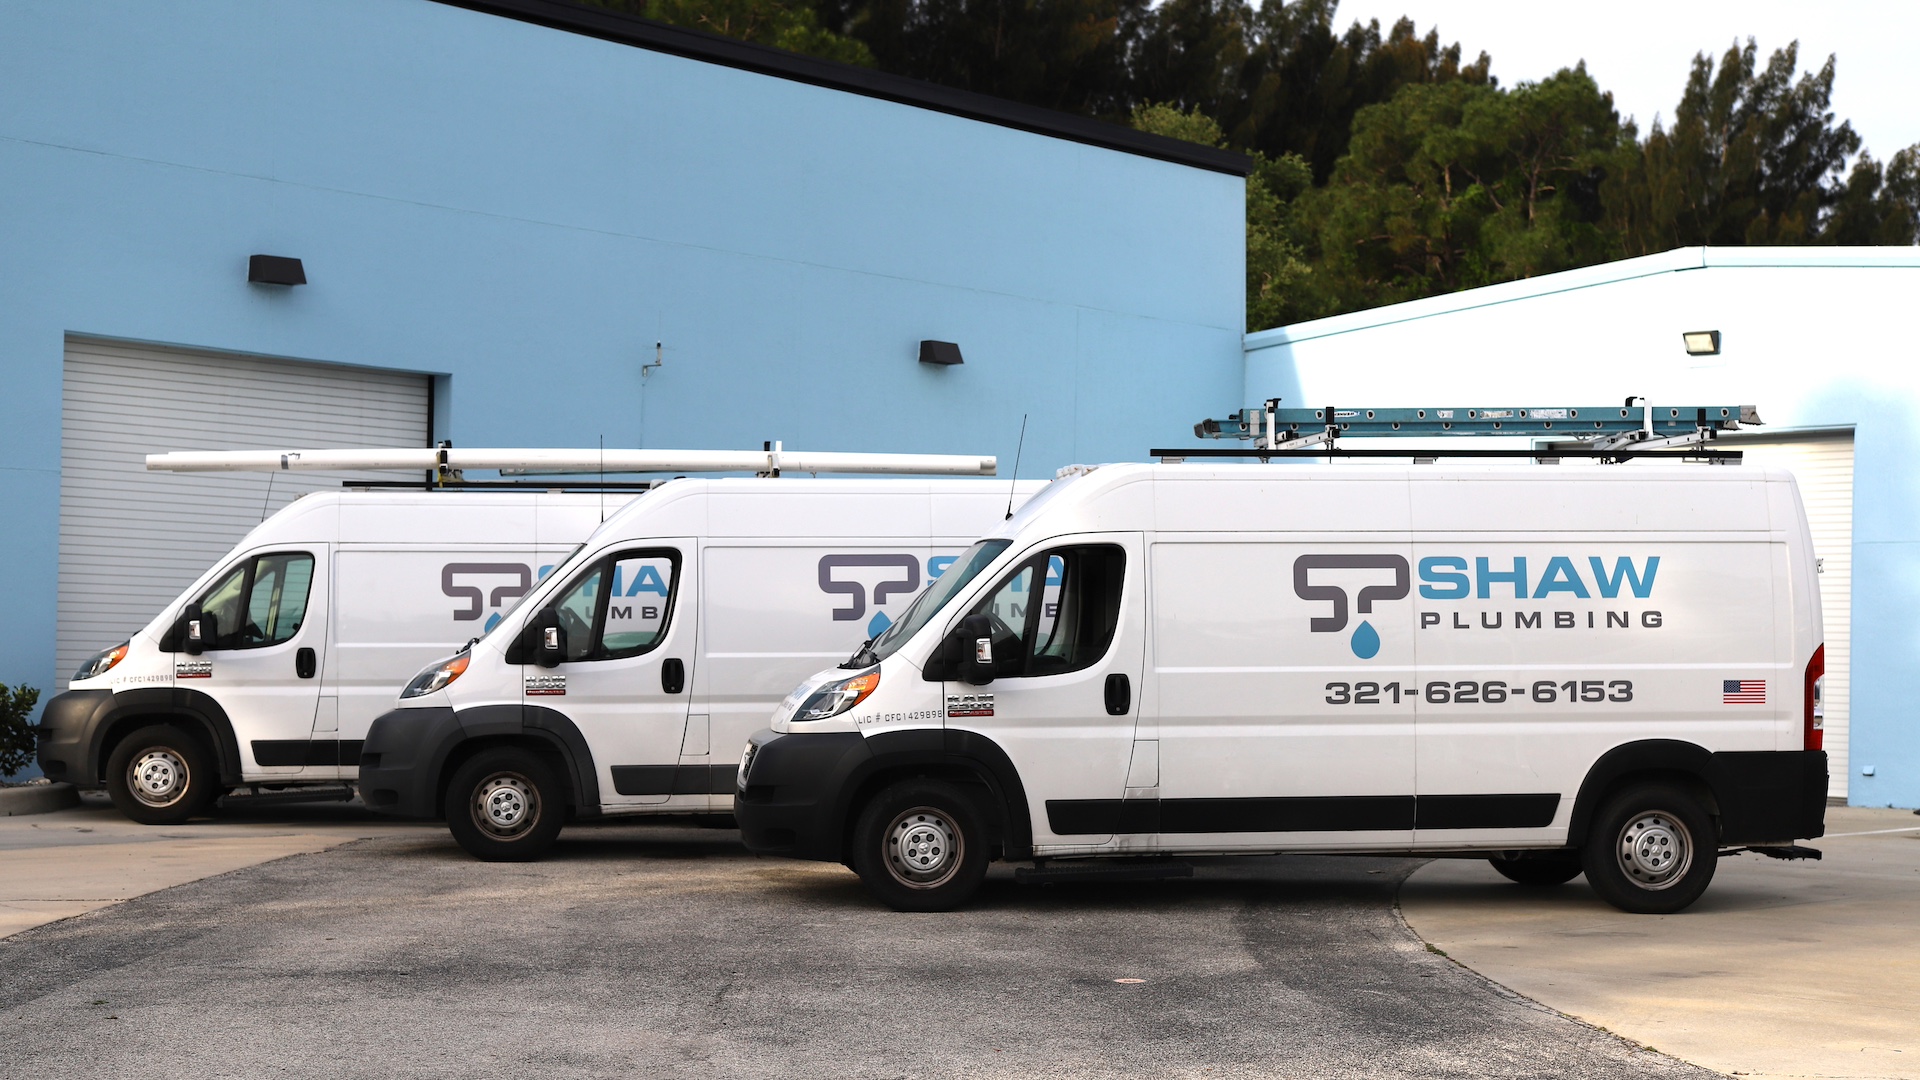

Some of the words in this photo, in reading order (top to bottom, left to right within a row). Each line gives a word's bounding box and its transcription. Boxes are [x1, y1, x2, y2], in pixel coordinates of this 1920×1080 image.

[1418, 556, 1661, 599] SHAW
[1420, 610, 1663, 630] PLUMBING
[947, 693, 994, 702] RAM
[1325, 680, 1633, 704] 321-626-6153
[947, 701, 994, 709] 2500
[858, 715, 872, 724] LIC
[884, 710, 943, 722] CFC1429898
